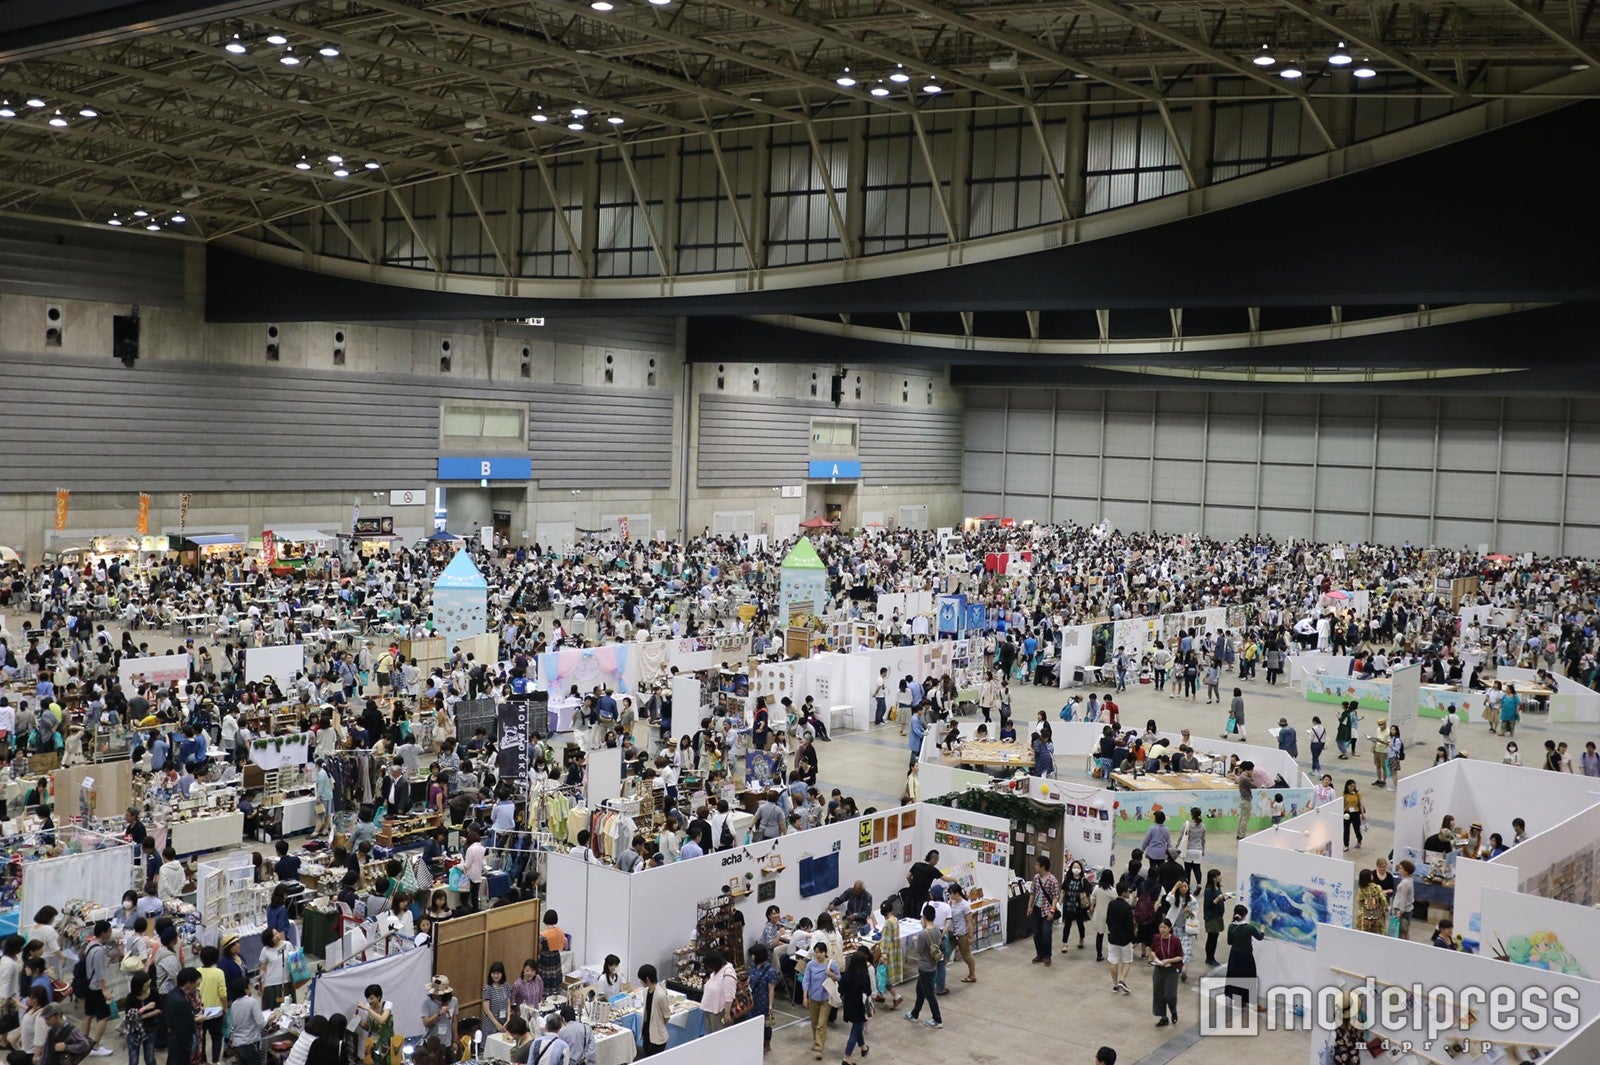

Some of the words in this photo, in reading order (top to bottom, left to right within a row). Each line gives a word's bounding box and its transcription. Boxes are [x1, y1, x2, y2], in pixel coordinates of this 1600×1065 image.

[481, 461, 491, 476] B
[832, 463, 839, 475] A
[721, 853, 742, 867] acha
